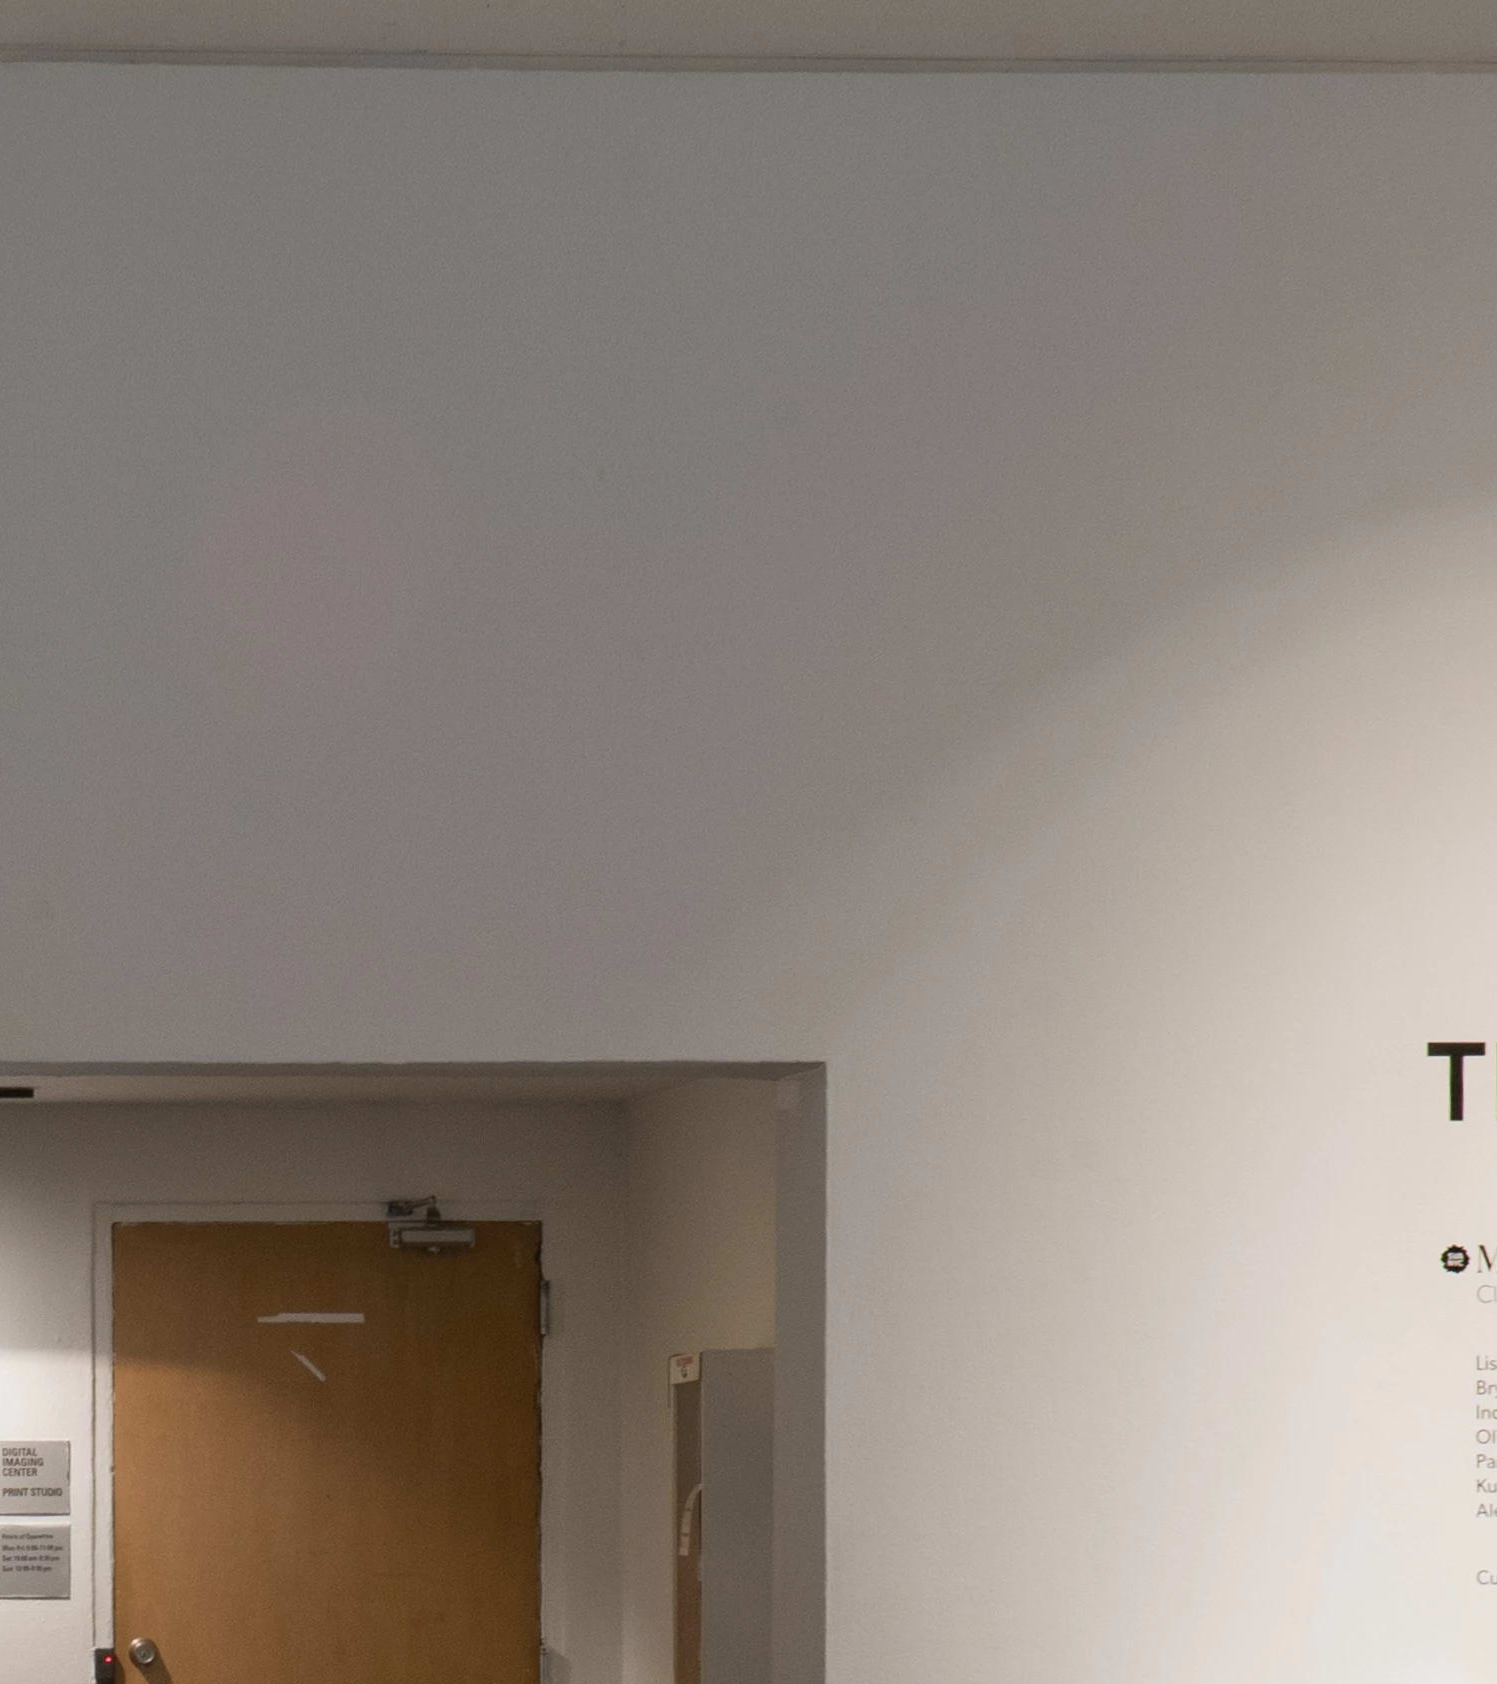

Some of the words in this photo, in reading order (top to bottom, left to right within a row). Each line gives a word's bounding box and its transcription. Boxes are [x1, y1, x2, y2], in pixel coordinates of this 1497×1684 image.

[1, 1447, 38, 1457] DIGITAL
[1, 1457, 44, 1467] IMAGING
[1, 1467, 38, 1477] CENTER
[1, 1487, 29, 1497] PRINT
[30, 1487, 63, 1497] STUDIO
